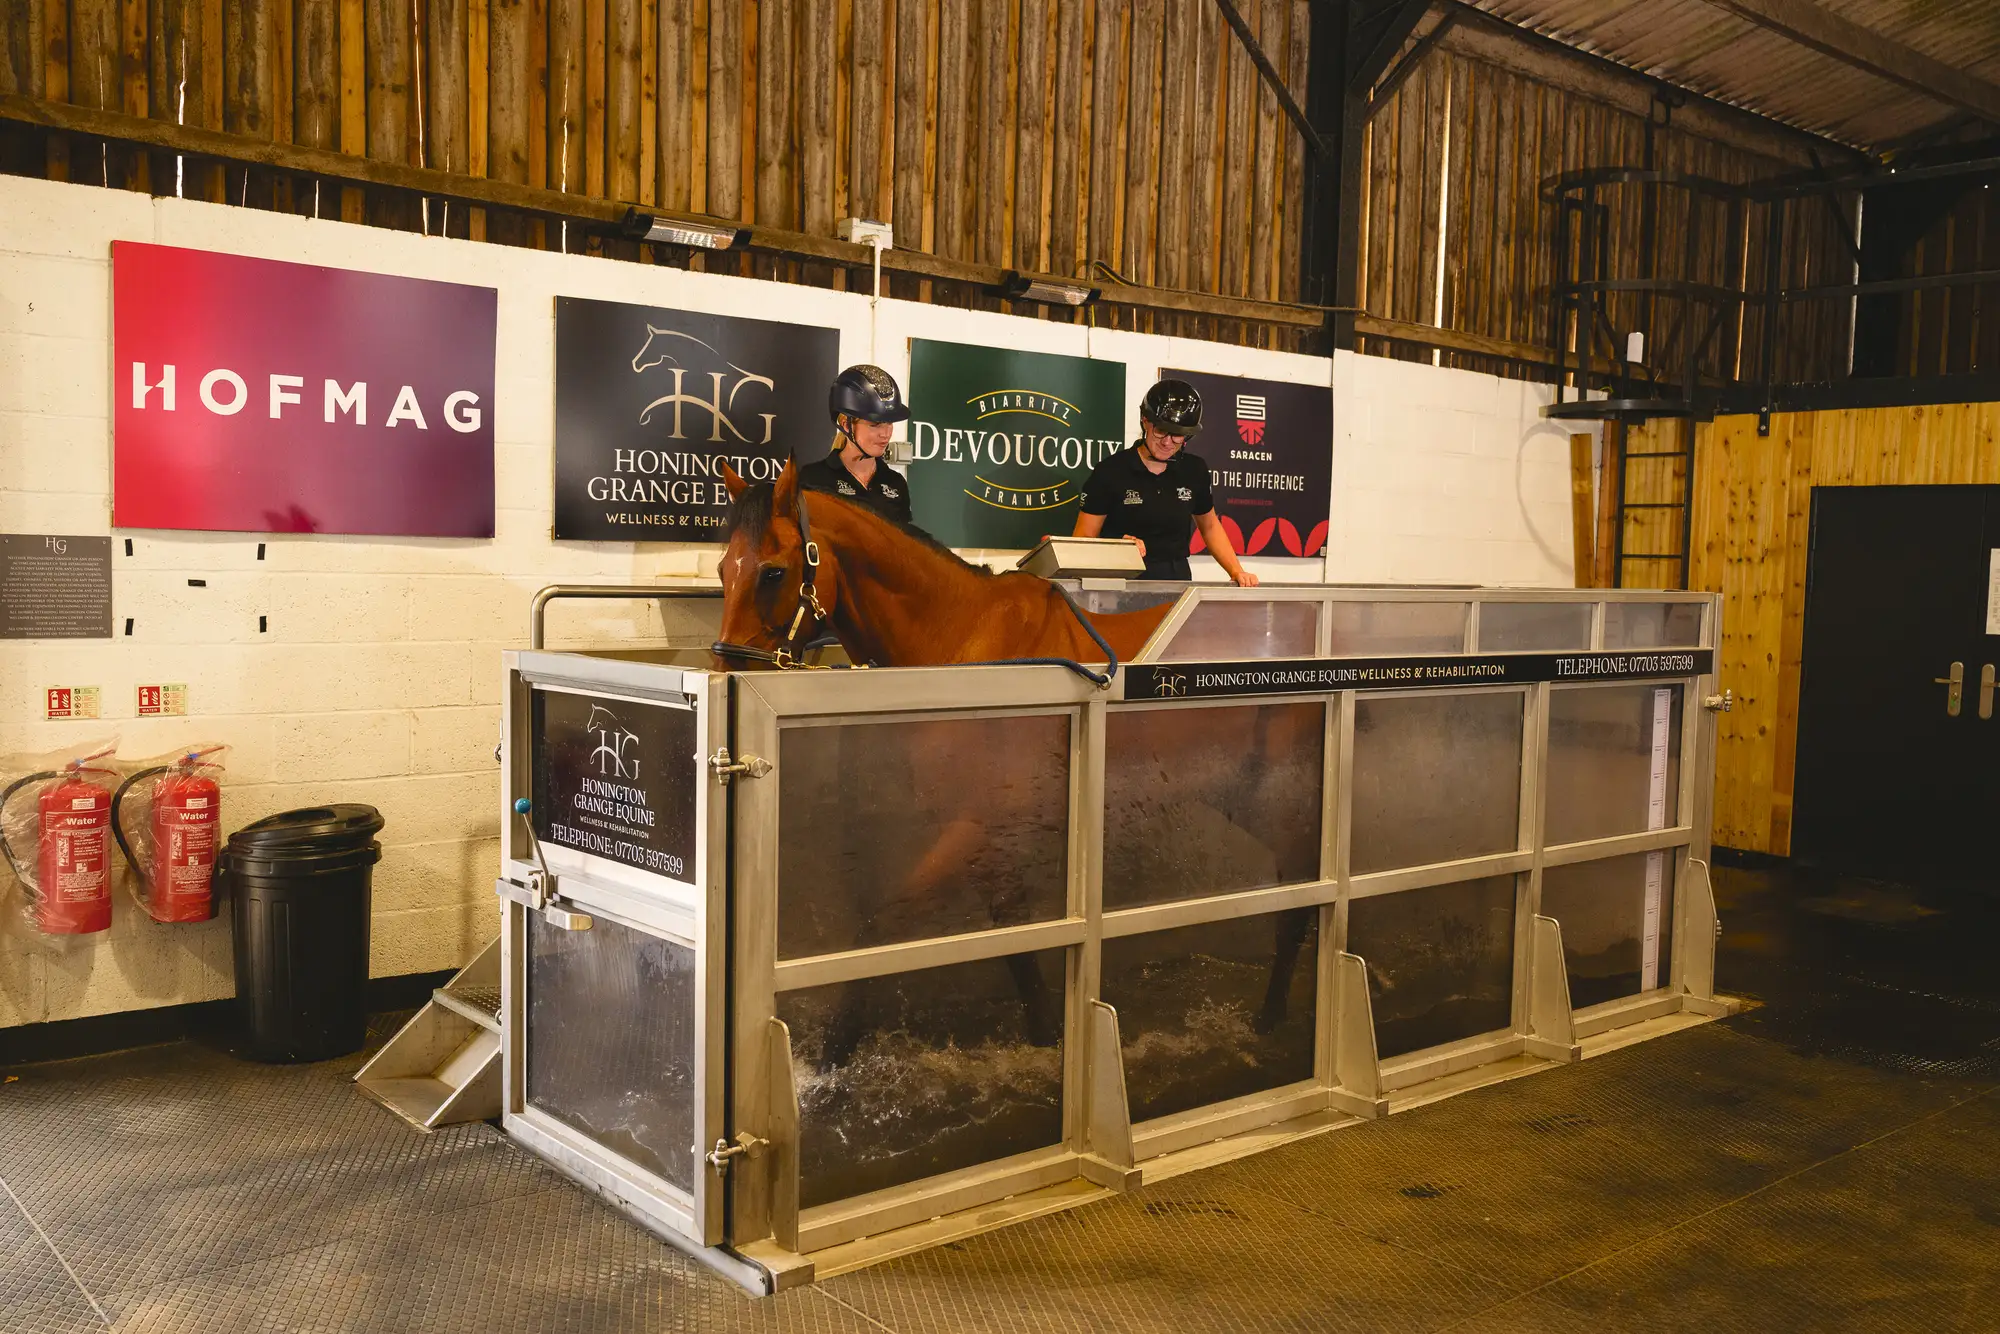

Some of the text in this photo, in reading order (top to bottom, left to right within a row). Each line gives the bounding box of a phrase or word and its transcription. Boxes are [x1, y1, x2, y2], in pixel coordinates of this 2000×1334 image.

[132, 361, 482, 433] HOFMAG
[979, 395, 1071, 420] BIARRITZ
[614, 449, 789, 480] HONINGTON
[1230, 450, 1272, 461] SARACEN
[587, 477, 706, 505] GRANGE
[1223, 471, 1242, 488] THE
[1245, 472, 1305, 491] DIFFERENCE
[984, 486, 1060, 507] FRANCE
[606, 512, 675, 526] WELLNESS
[679, 515, 688, 526] &
[1196, 672, 1272, 687] HONINGTON
[1272, 671, 1316, 684] GRANGE
[1318, 669, 1358, 683] EQUINE
[1358, 668, 1411, 680] WELLNESS
[1414, 668, 1423, 678] &
[1426, 665, 1505, 678] REHABILITATION
[1556, 655, 1693, 675] TELEPHONE: 07703 597599
[582, 777, 646, 806] HONINGTON
[66, 817, 97, 825] Water
[180, 812, 209, 820] Water
[574, 793, 655, 827] GRANGE EQUINE
[579, 815, 603, 828] WELLNESS
[608, 822, 649, 839] REHABILITATION
[551, 823, 683, 875] TELEPHONE: 07703 597599
